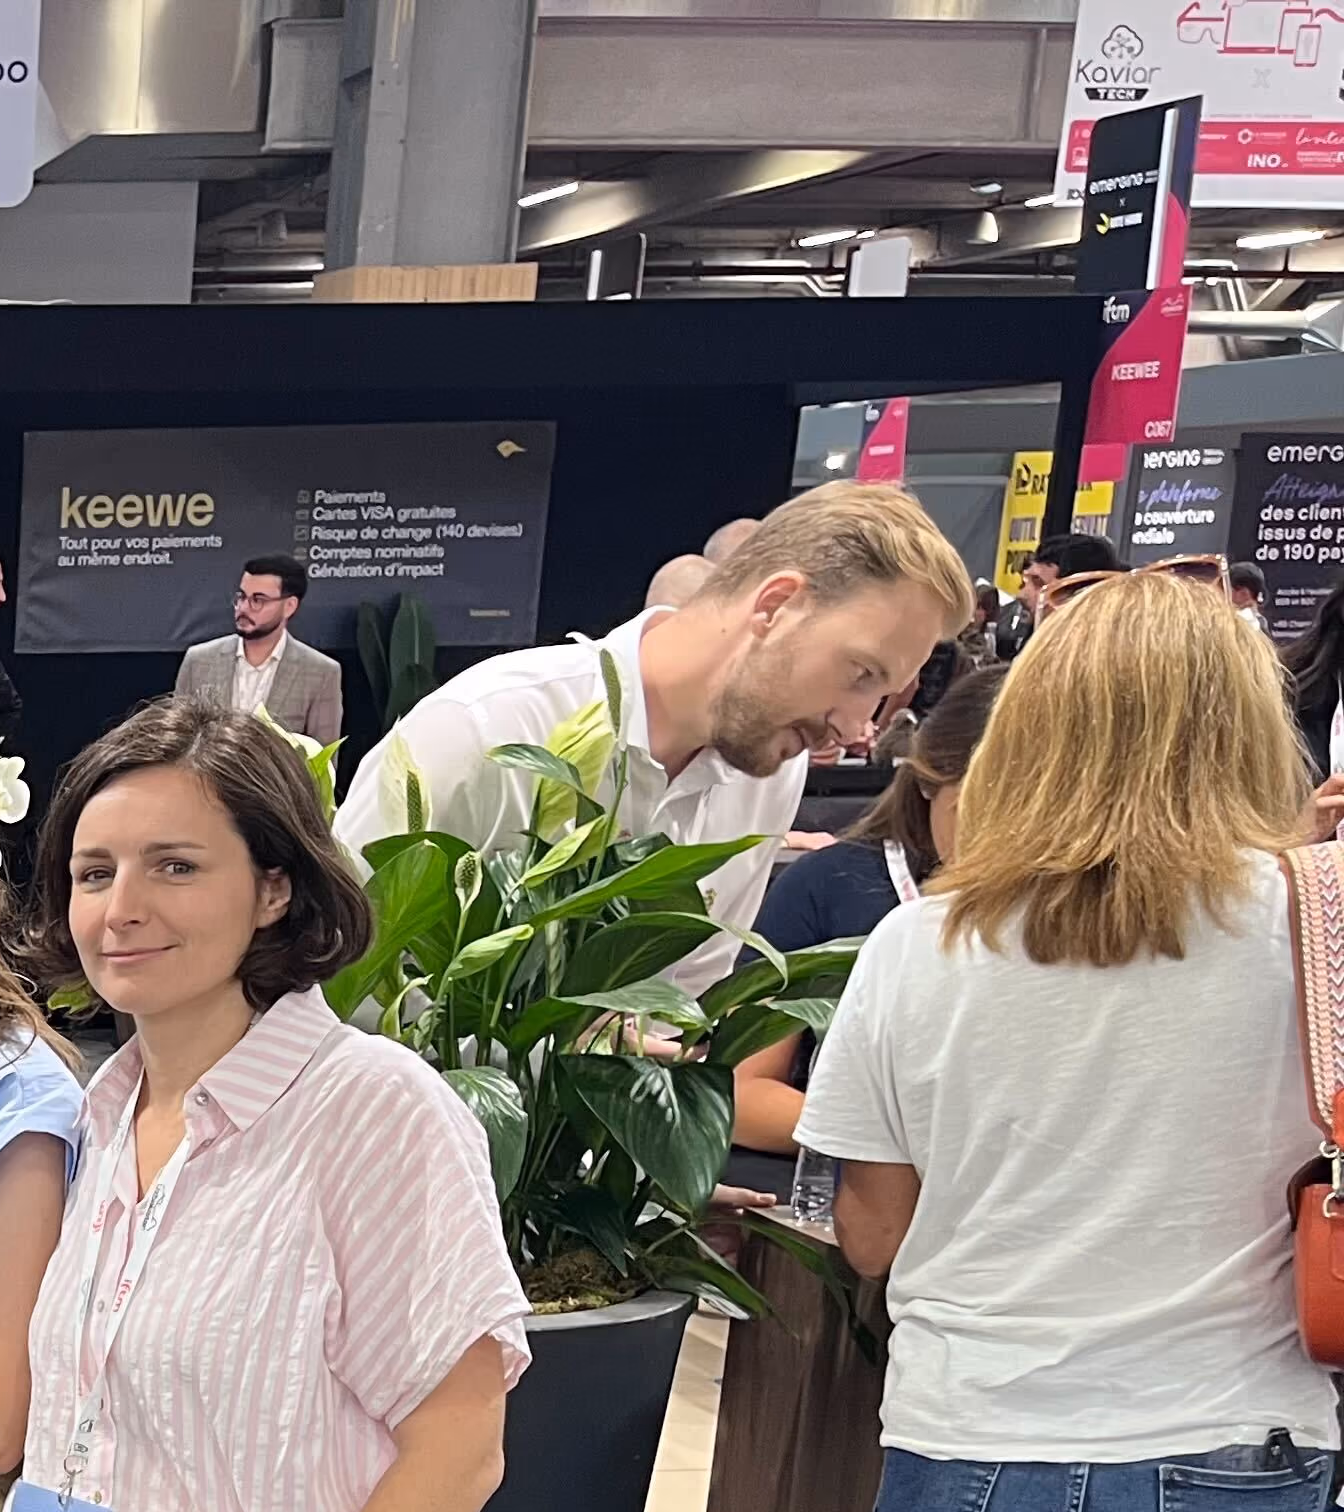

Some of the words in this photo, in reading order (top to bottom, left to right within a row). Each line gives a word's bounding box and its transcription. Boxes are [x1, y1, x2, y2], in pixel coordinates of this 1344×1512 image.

[1075, 59, 1161, 84] Kaviar
[1097, 88, 1135, 100] TECH
[1112, 361, 1160, 381] KEEWEE
[314, 489, 386, 504] Paiements
[60, 486, 215, 529] keewe
[312, 507, 358, 521] Cartes
[361, 506, 394, 520] VISA
[397, 505, 456, 523] gratuites
[1260, 505, 1294, 521] des
[312, 526, 358, 543] Risque
[361, 526, 379, 541] de
[381, 526, 433, 542] change
[1258, 524, 1306, 541] issus
[1310, 525, 1333, 541] de
[58, 536, 88, 550] Tout
[91, 538, 123, 552] pour
[125, 538, 150, 549] vos
[152, 534, 223, 551] paiements
[57, 555, 75, 567] au
[78, 552, 120, 567] même
[123, 552, 174, 566] endroit.
[309, 545, 372, 563] Comptes
[374, 543, 445, 559] nominatifs
[1255, 545, 1280, 560] de
[1283, 544, 1314, 560] 190
[308, 561, 382, 578] Génération
[385, 562, 444, 578] d'impact
